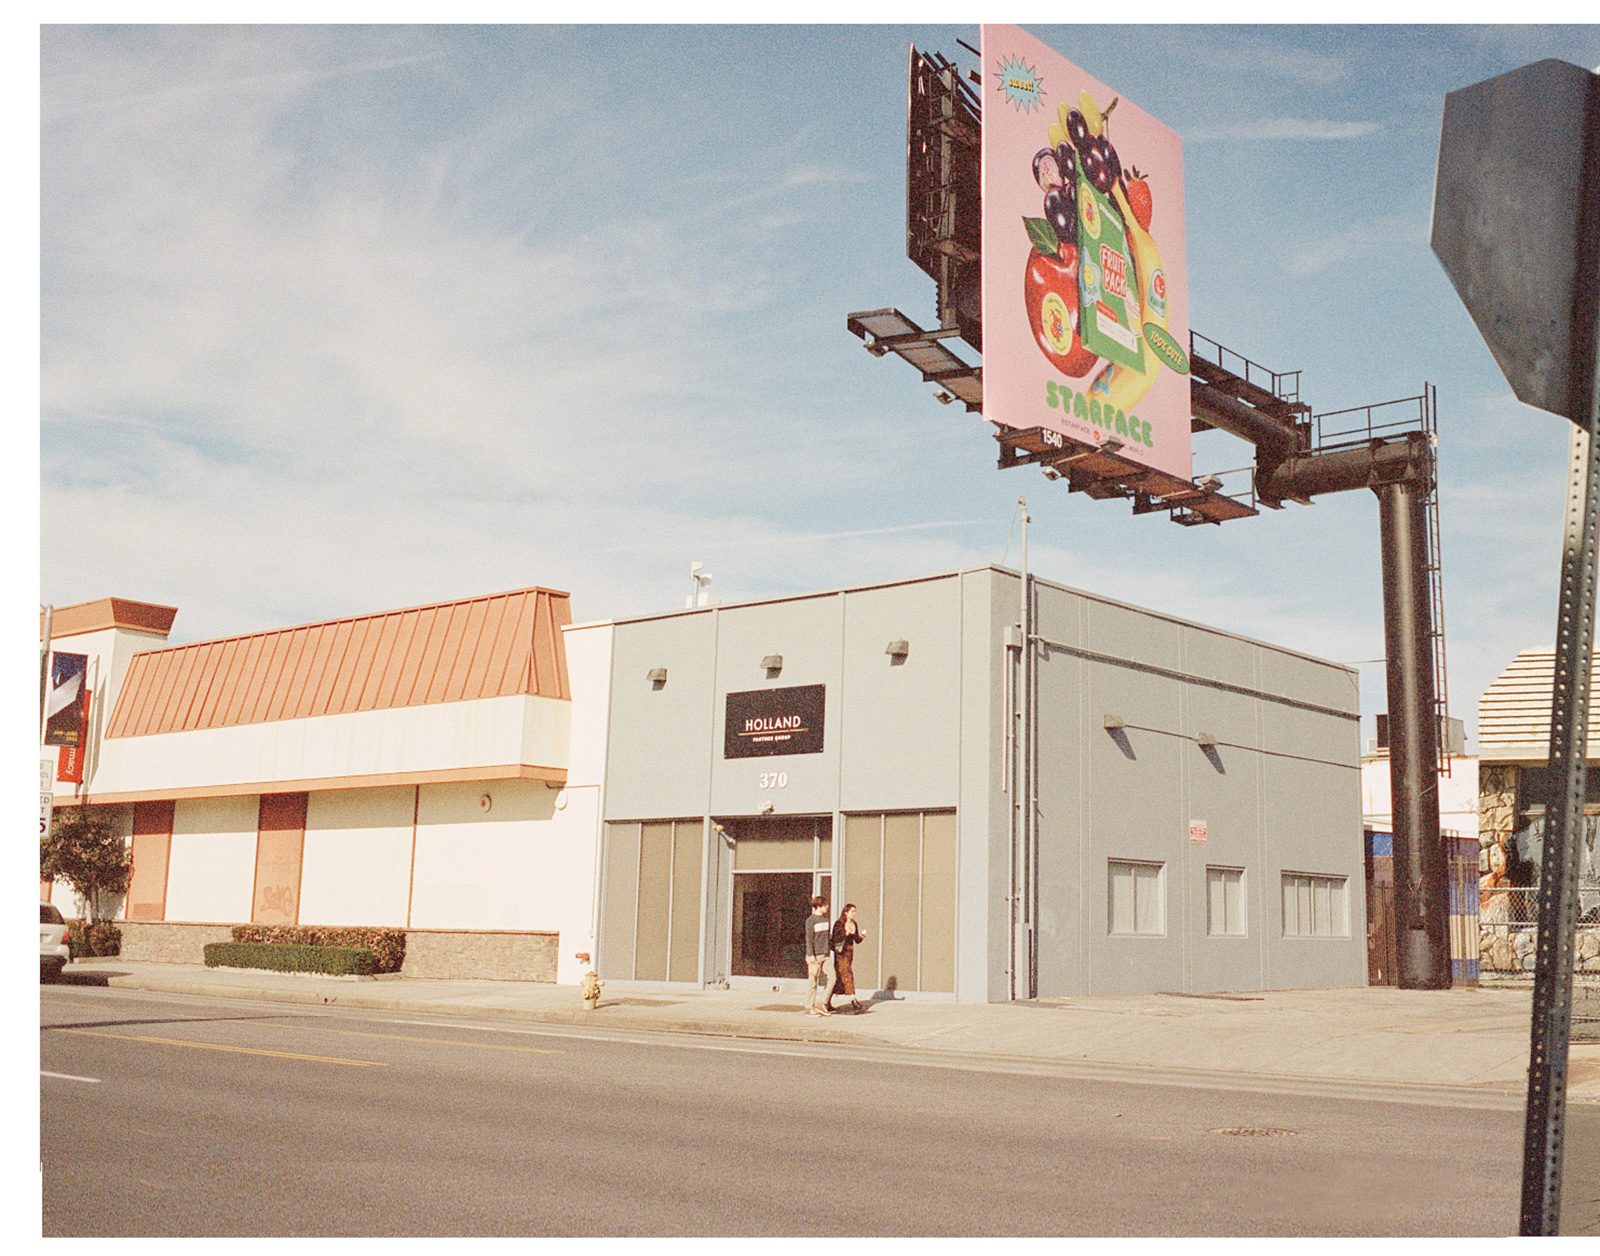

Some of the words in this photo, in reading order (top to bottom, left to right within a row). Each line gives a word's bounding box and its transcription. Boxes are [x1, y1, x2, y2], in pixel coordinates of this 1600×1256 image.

[1101, 245, 1127, 273] FRUIT
[1104, 268, 1128, 298] PACK
[1150, 331, 1168, 353] 100%
[1166, 346, 1184, 367] CUTE
[1046, 380, 1153, 448] STARFACE
[1042, 429, 1063, 448] 1540
[745, 715, 801, 731] HOLLAND
[759, 772, 788, 789] 370
